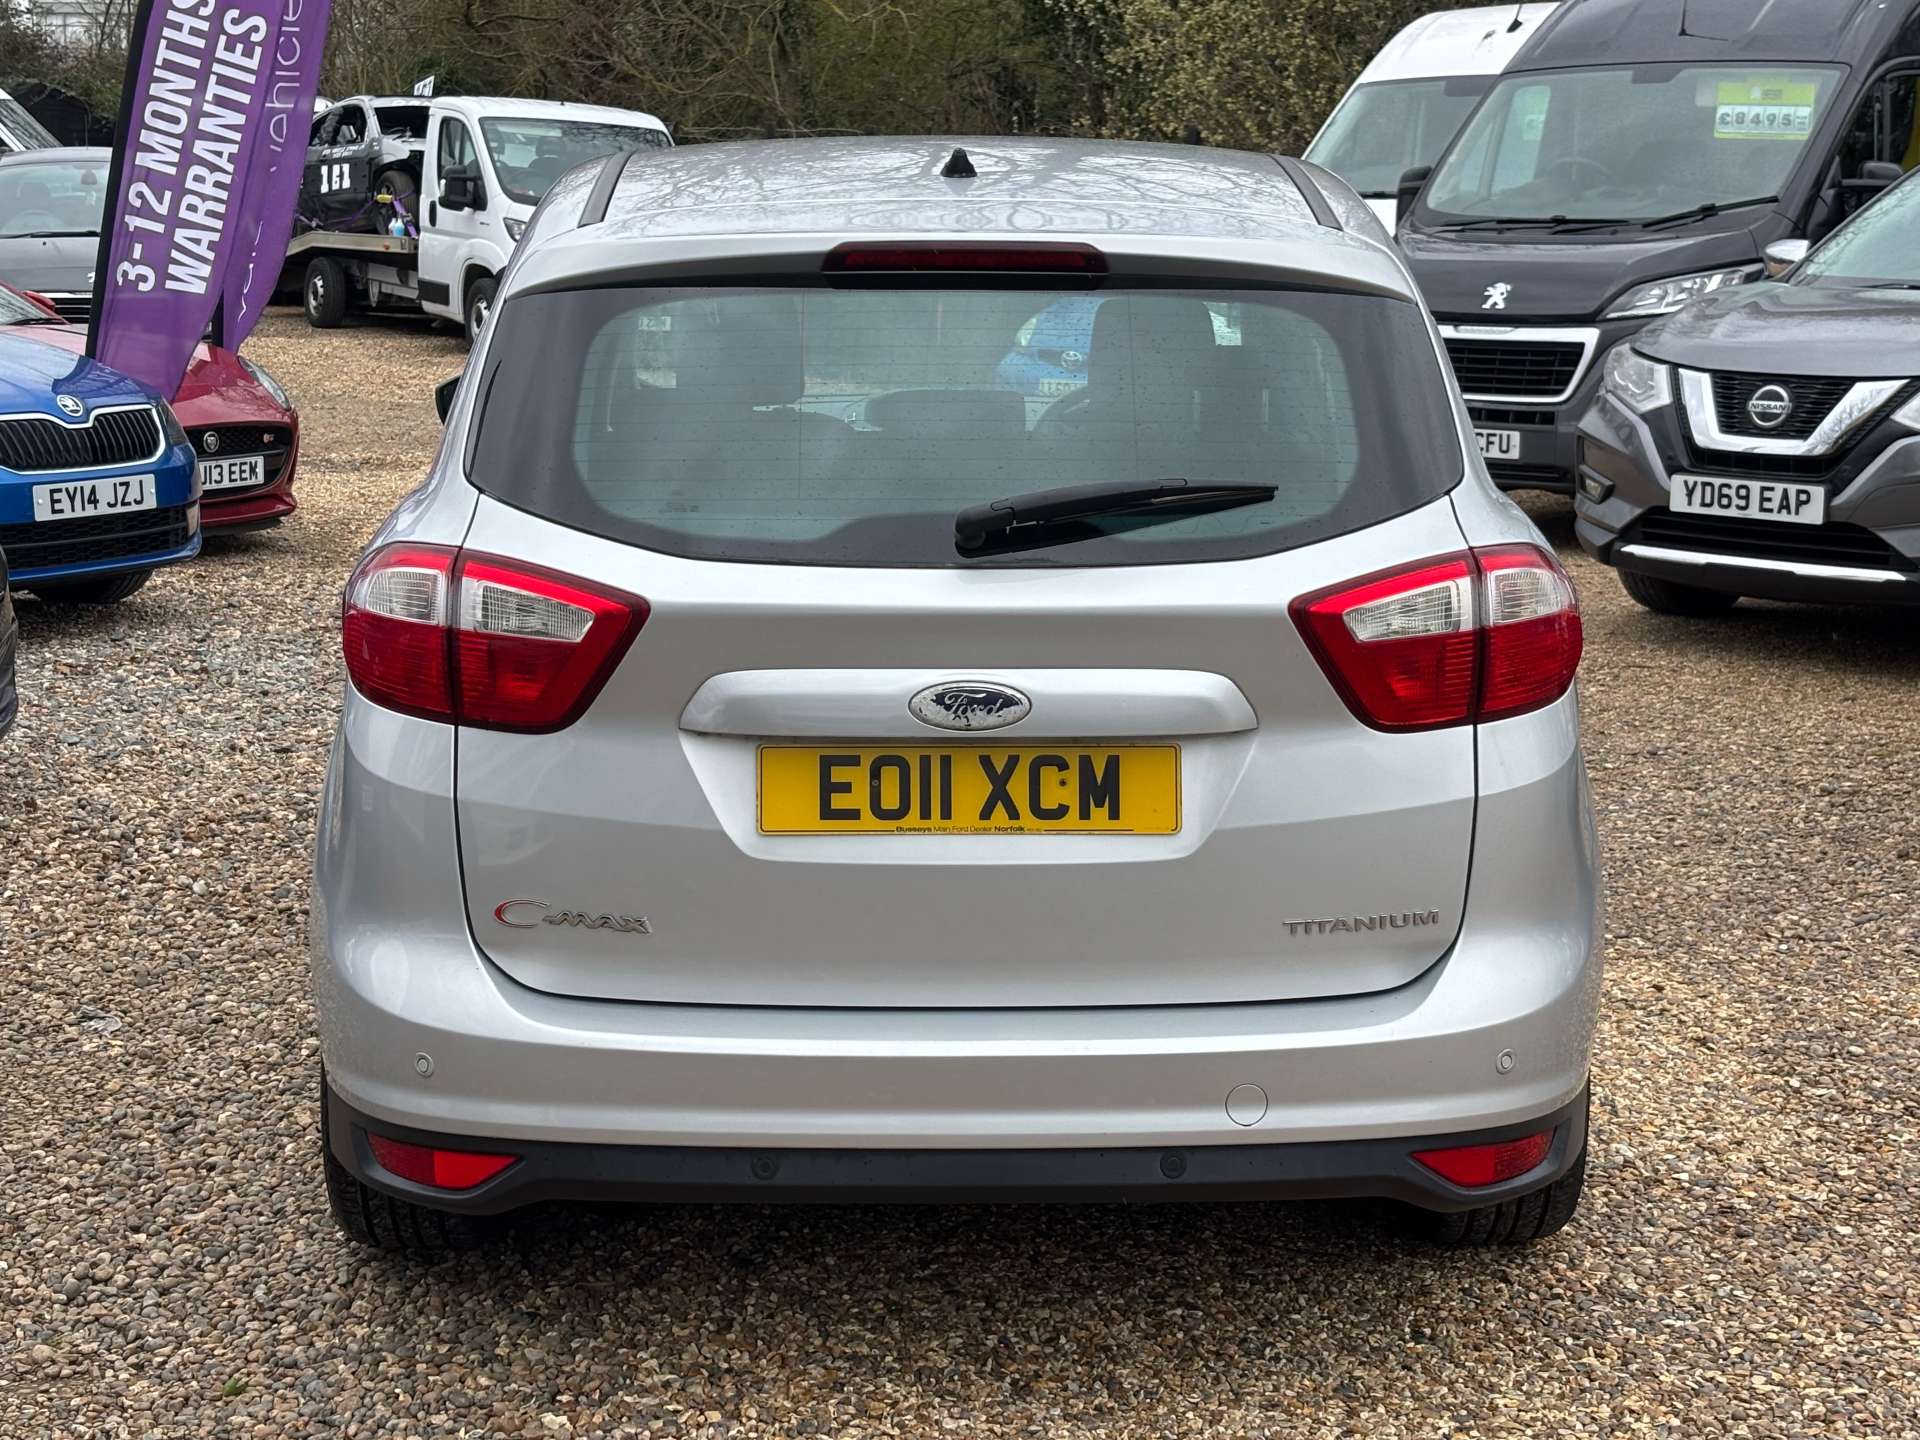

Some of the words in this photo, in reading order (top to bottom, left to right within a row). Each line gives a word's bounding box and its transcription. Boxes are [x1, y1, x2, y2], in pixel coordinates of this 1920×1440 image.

[164, 8, 267, 295] WARRANTIES
[320, 163, 351, 194] 161
[116, 182, 172, 292] 3-12
[1750, 402, 1789, 412] NISSAN
[229, 460, 259, 483] EEM
[49, 484, 98, 515] EY14
[107, 480, 145, 508] JZJ
[1683, 479, 1750, 511] YD69
[1758, 485, 1812, 516] EAP
[944, 692, 1003, 717] Ford
[818, 754, 952, 821] EO11
[978, 754, 1121, 821] XCM
[994, 825, 1025, 833] Norfolk
[1282, 909, 1440, 936] TITANIUM
